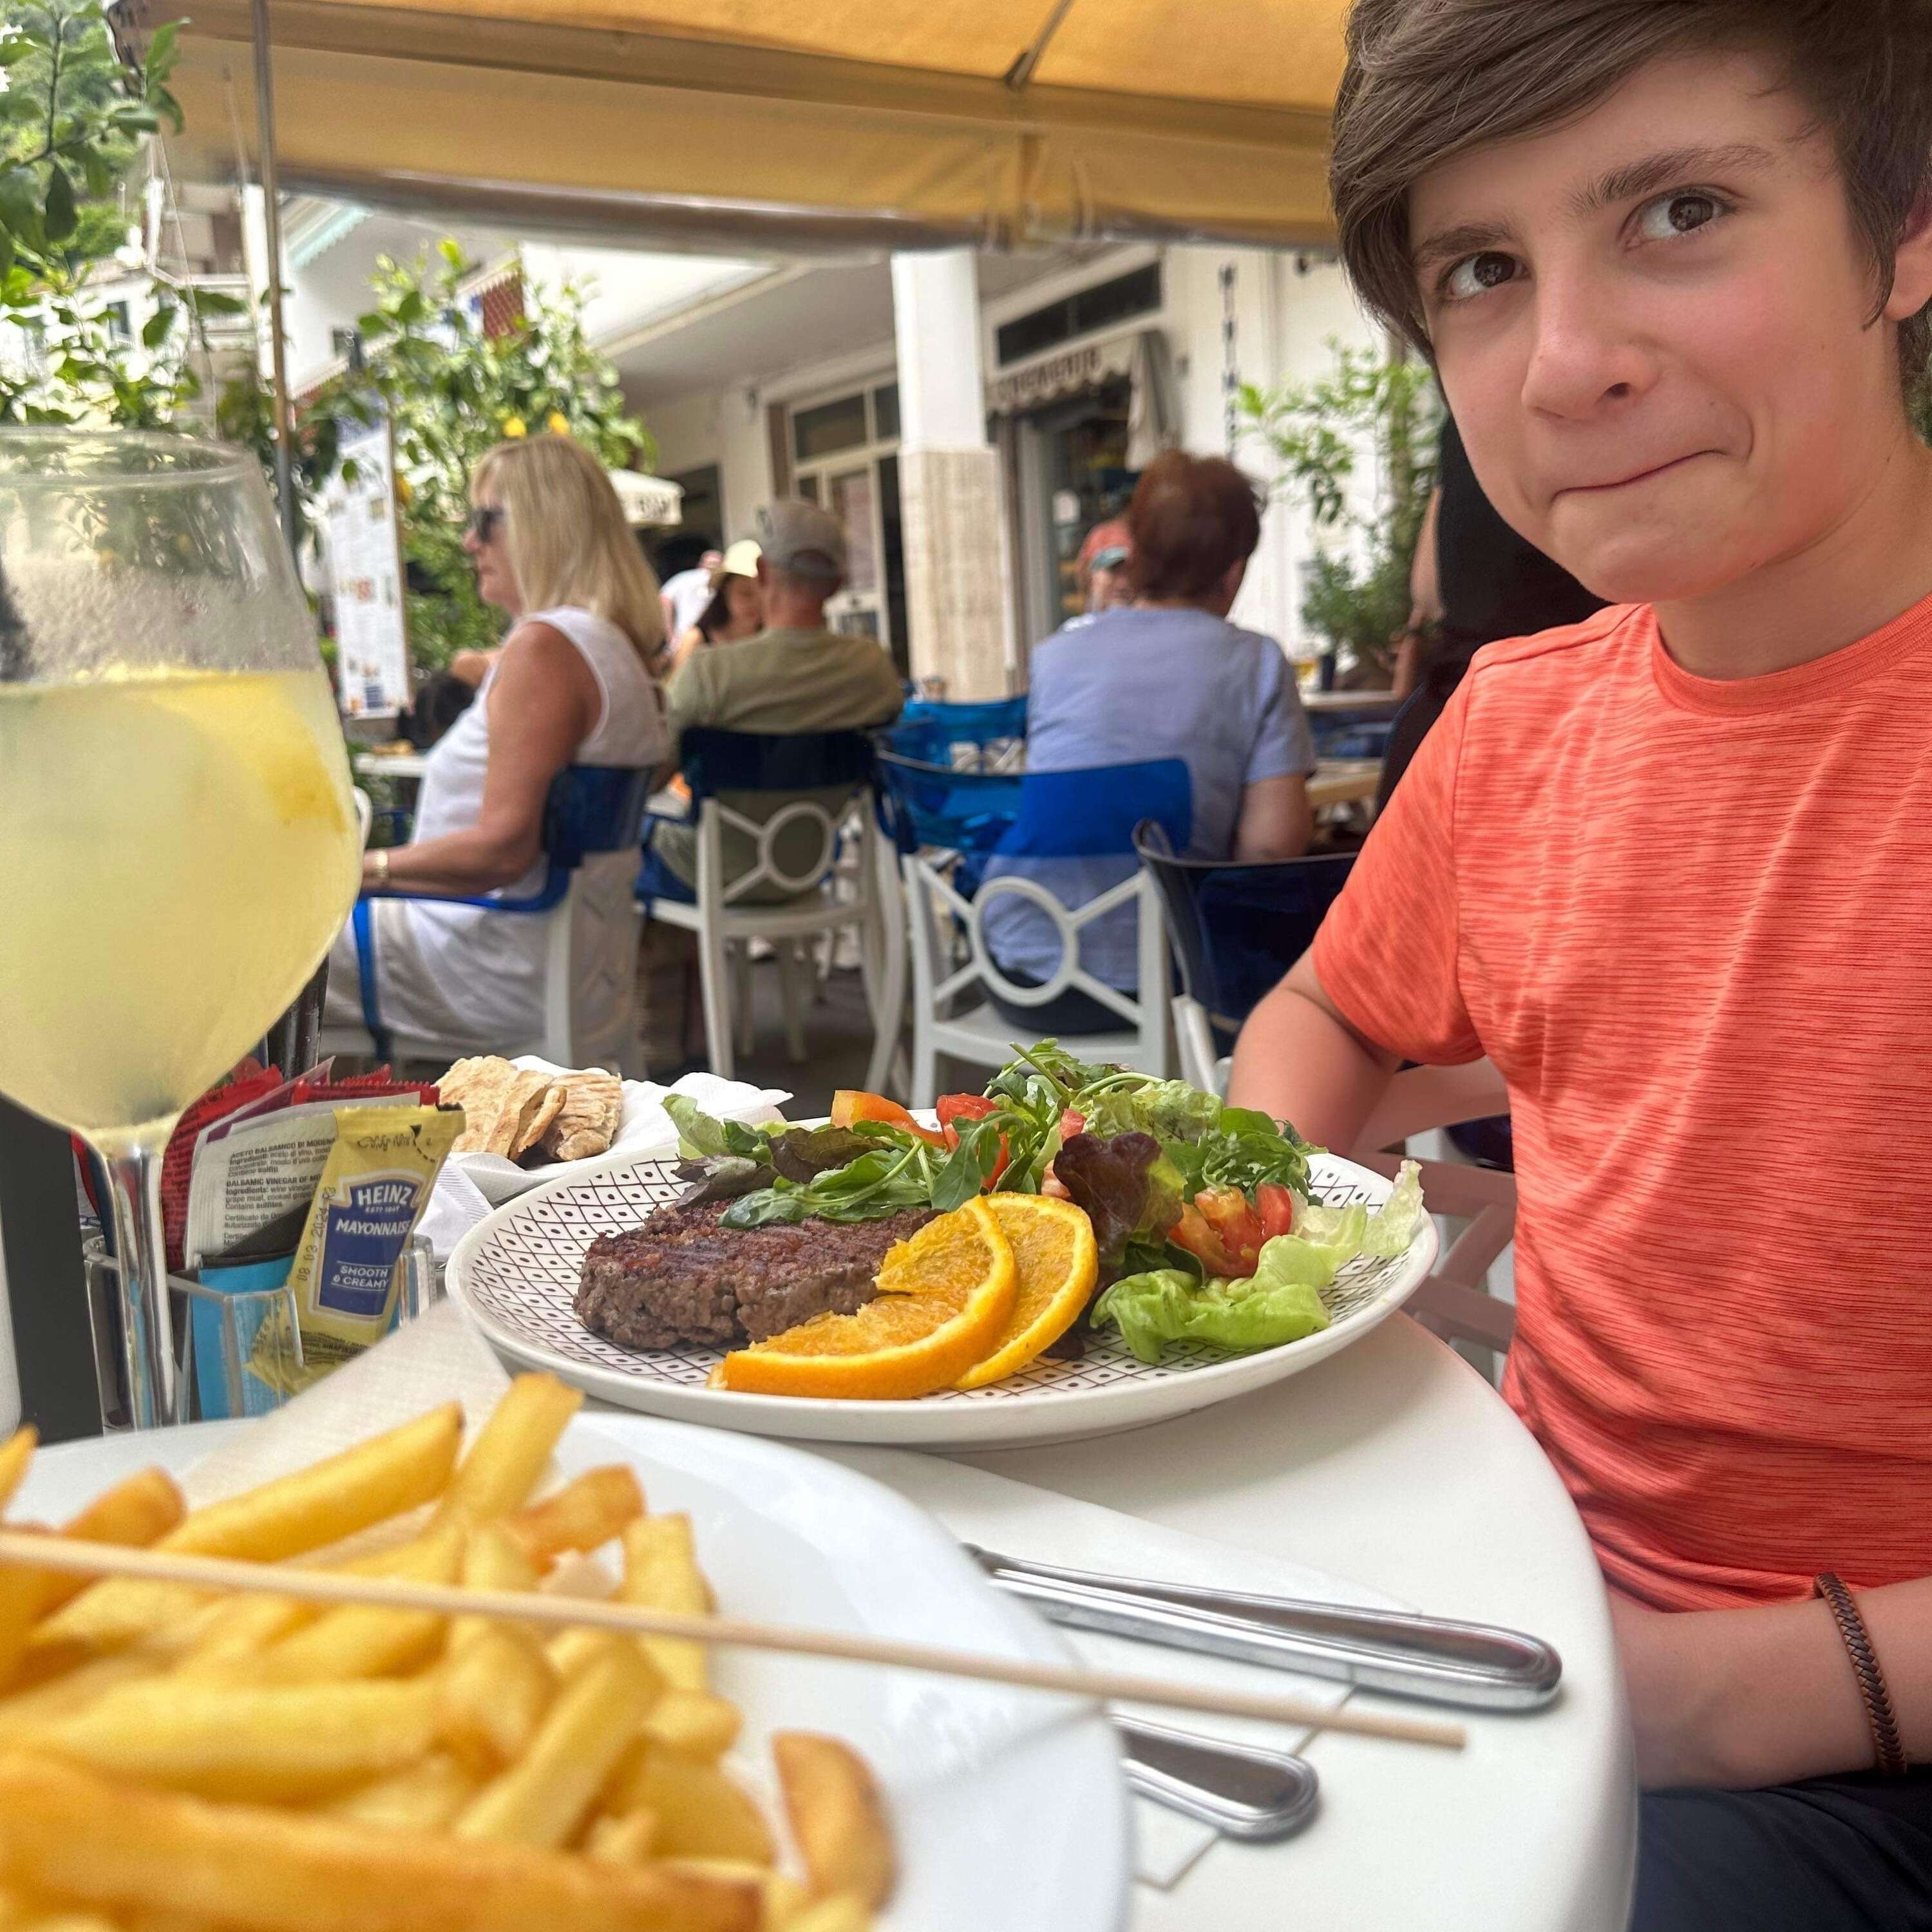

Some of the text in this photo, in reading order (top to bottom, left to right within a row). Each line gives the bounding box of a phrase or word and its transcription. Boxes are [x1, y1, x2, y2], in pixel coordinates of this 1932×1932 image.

[226, 1178, 264, 1187] BALSAMIC
[266, 1177, 298, 1185] VINEGAR
[357, 1184, 413, 1206] HEINZ
[340, 1264, 389, 1277] SMOOTH
[333, 1274, 390, 1289] & CREAMY
